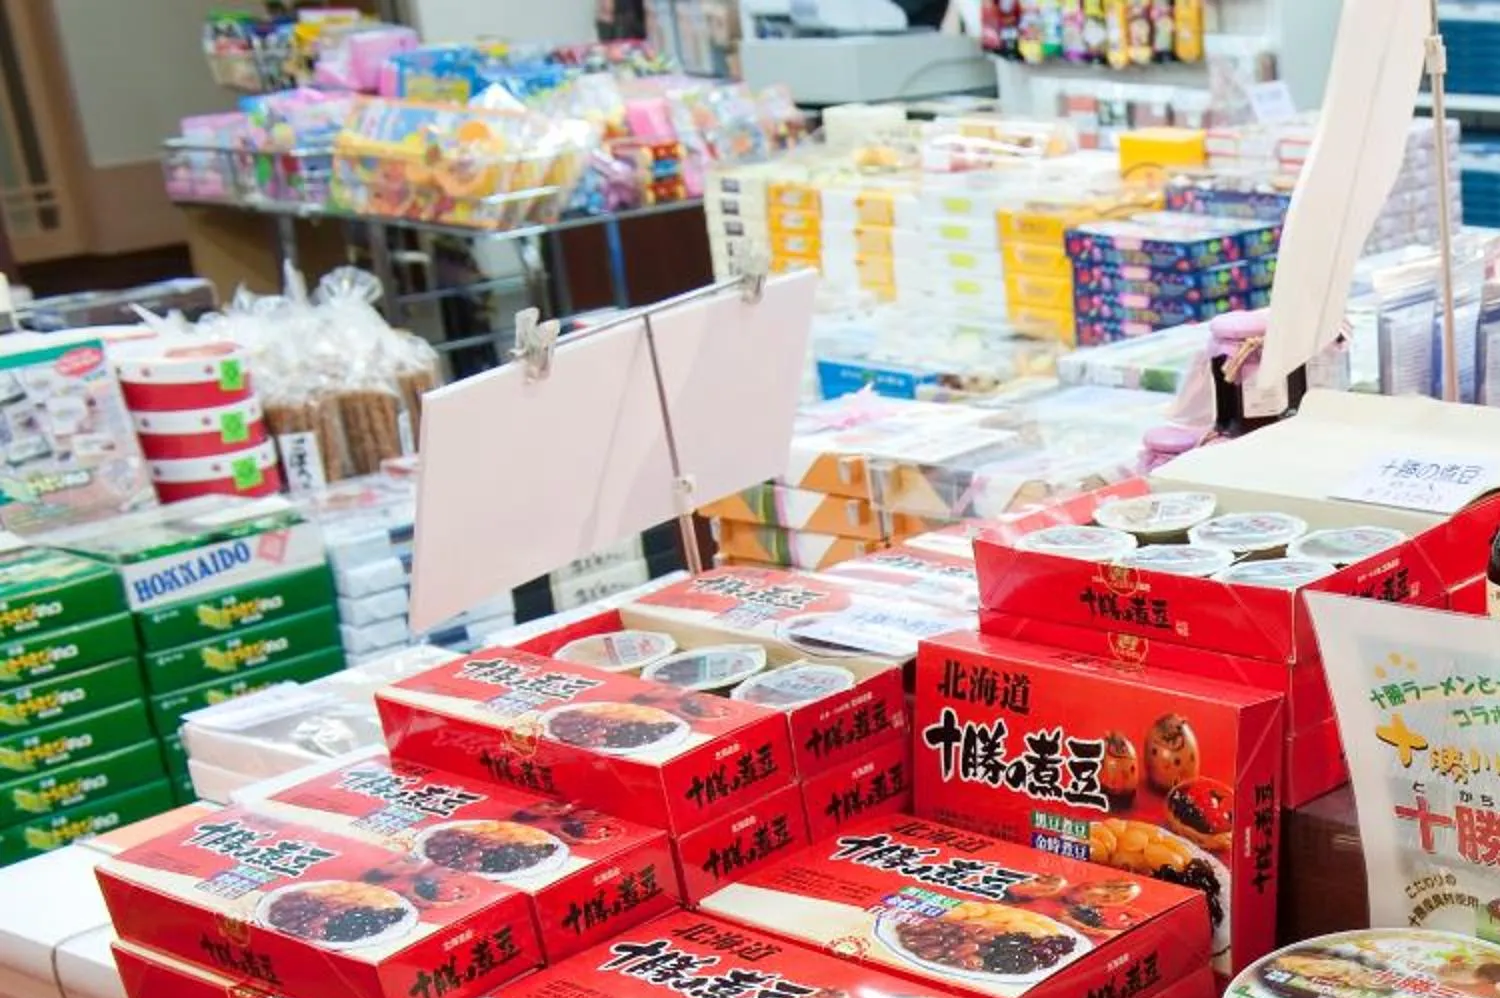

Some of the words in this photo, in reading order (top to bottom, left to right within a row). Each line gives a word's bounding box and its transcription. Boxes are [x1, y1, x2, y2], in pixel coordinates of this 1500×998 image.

[132, 541, 251, 602] HOKKAIDO
[938, 659, 1031, 715] 北海道
[923, 707, 1109, 812] 十勝の煮豆
[672, 923, 782, 961] 北海道
